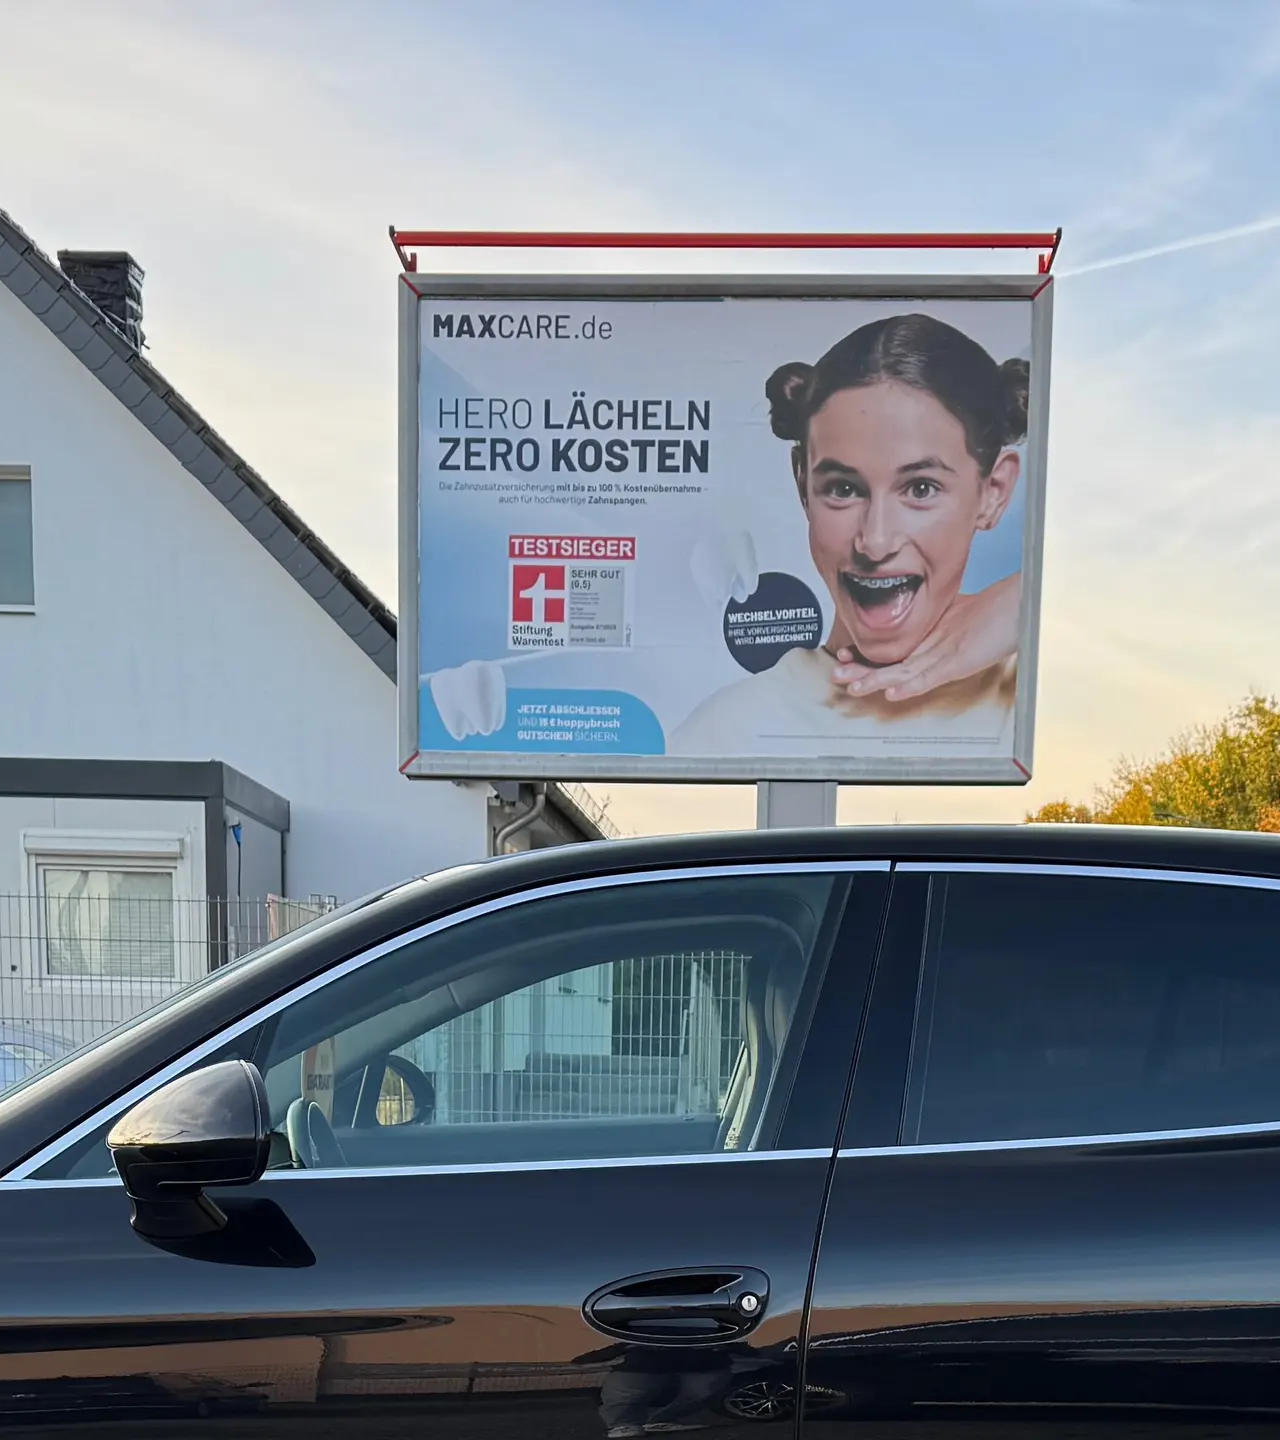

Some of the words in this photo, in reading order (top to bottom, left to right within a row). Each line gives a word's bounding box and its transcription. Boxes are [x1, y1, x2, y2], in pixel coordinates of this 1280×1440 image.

[432, 314, 613, 339] MAXCARE.de
[438, 397, 533, 430] HERO
[544, 391, 710, 431] LÄCHELN
[438, 436, 540, 472] ZERO
[551, 438, 709, 474] KOSTEN
[438, 482, 453, 492] Die
[454, 481, 555, 494] Zahnzusatzversicherung
[556, 483, 570, 492] mit
[572, 483, 586, 493] bis
[587, 485, 597, 493] zu
[598, 484, 613, 493] 100
[623, 484, 701, 494] Kostenübernahme
[498, 495, 519, 504] auch
[520, 495, 533, 505] für
[534, 495, 587, 506] hochwertige
[588, 496, 648, 506] Zahnspangen.
[511, 538, 633, 557] TESTSIEGER
[571, 569, 598, 579] SEHR
[600, 570, 621, 579] GUT
[728, 608, 817, 623] WECHSELVORTEIL
[512, 625, 553, 637] Stiftung
[512, 636, 565, 647] Warentest
[517, 704, 548, 714] JETZT
[549, 705, 620, 715] ABSCHLIESSEN
[517, 717, 538, 727] UND
[557, 718, 620, 729] happybrush
[517, 730, 573, 740] GUTSCHEIN
